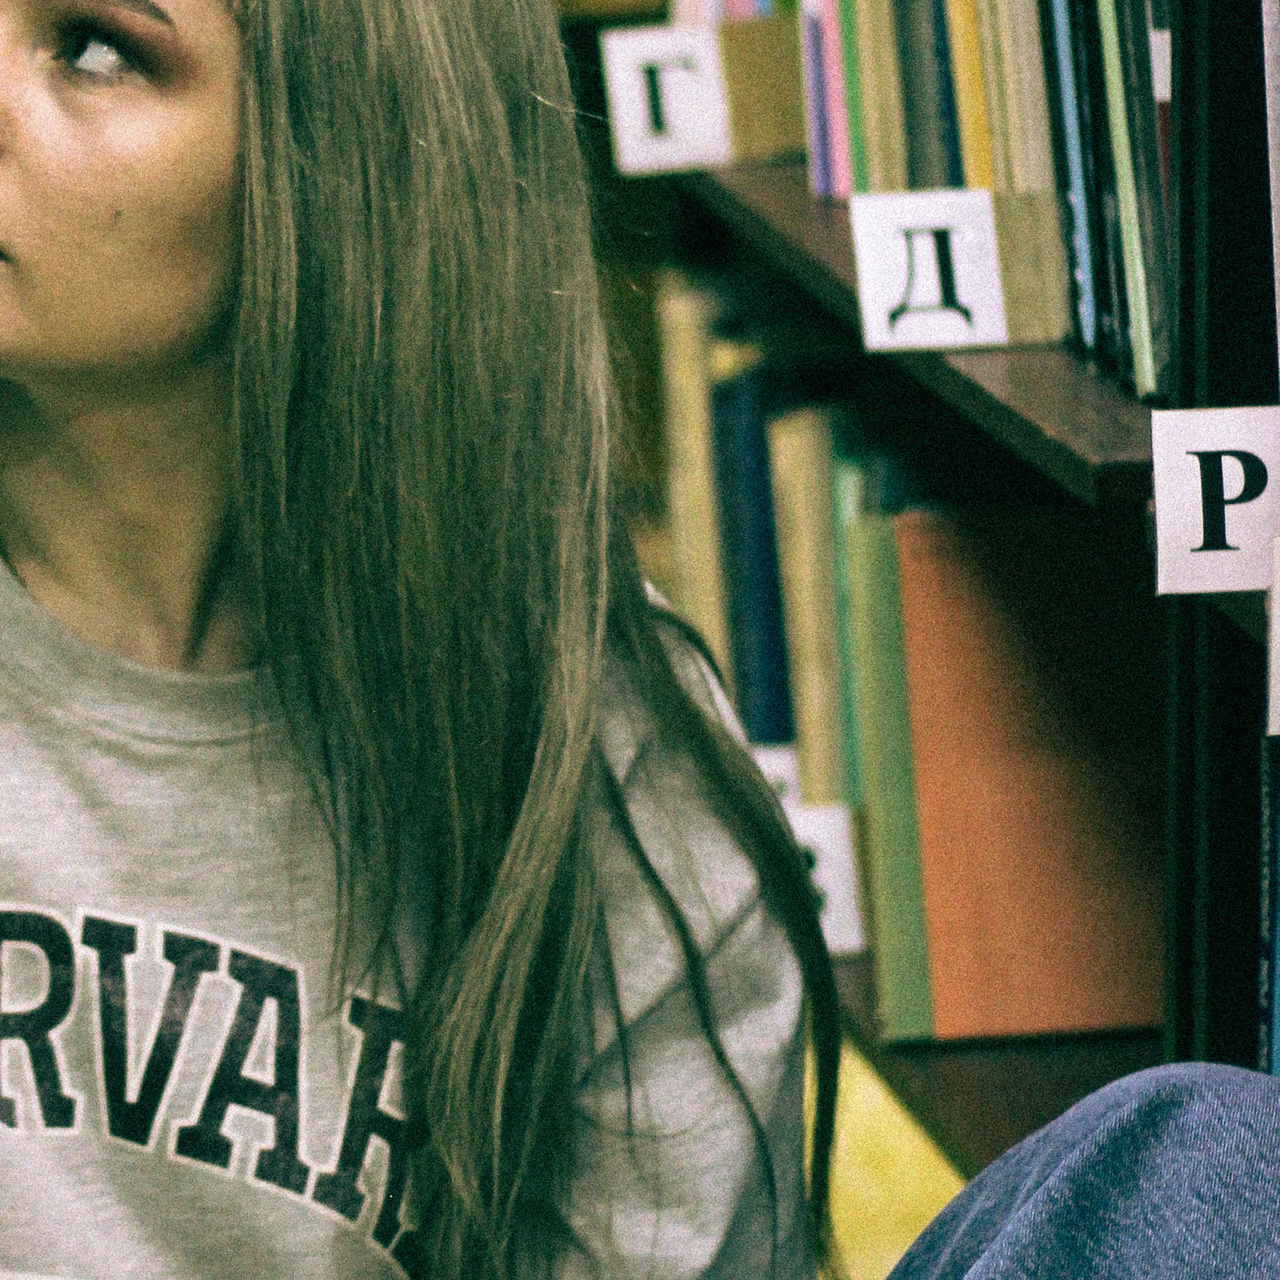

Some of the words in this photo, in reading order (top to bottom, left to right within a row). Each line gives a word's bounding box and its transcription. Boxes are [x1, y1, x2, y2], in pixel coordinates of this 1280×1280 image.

[639, 55, 698, 138] Г
[888, 226, 974, 336] Д
[1186, 449, 1269, 552] Р
